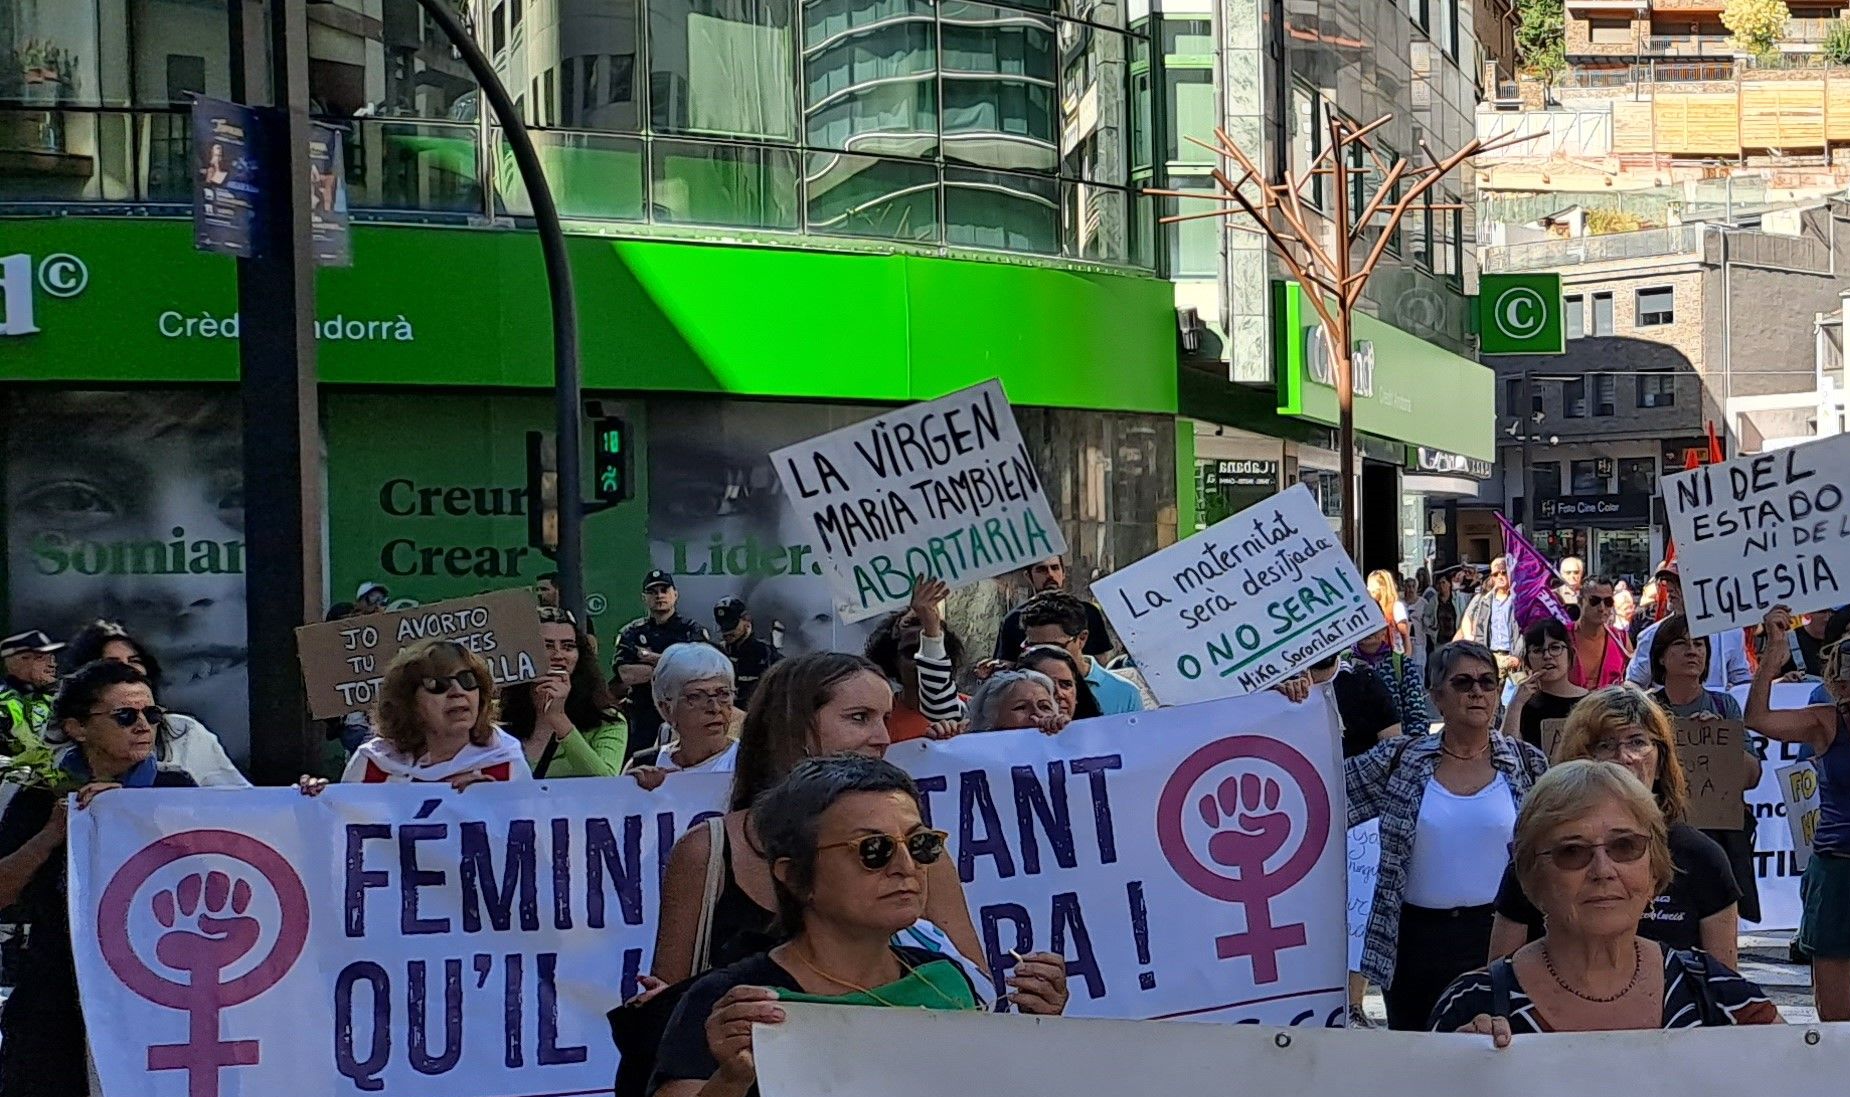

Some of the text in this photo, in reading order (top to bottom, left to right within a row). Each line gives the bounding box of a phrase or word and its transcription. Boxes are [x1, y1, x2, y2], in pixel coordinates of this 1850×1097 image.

[788, 391, 1001, 498] LA VIRGEN
[813, 443, 1038, 557] MARIA TAMBIEN
[1676, 449, 1816, 513] NI DEL
[1693, 483, 1842, 541] ESTADO
[1743, 522, 1777, 557] NI
[1793, 520, 1827, 546] DE
[32, 526, 246, 577] Somiar
[380, 539, 529, 577] Crear
[674, 531, 823, 577] Lider
[1119, 509, 1298, 619] La maternitat
[1179, 588, 1237, 630] serà
[1693, 555, 1839, 623] IGLESIA
[340, 607, 488, 650] JO AVORTO
[1206, 613, 1260, 667] NO
[346, 654, 376, 674] TU
[344, 798, 725, 938] FÉMINI
